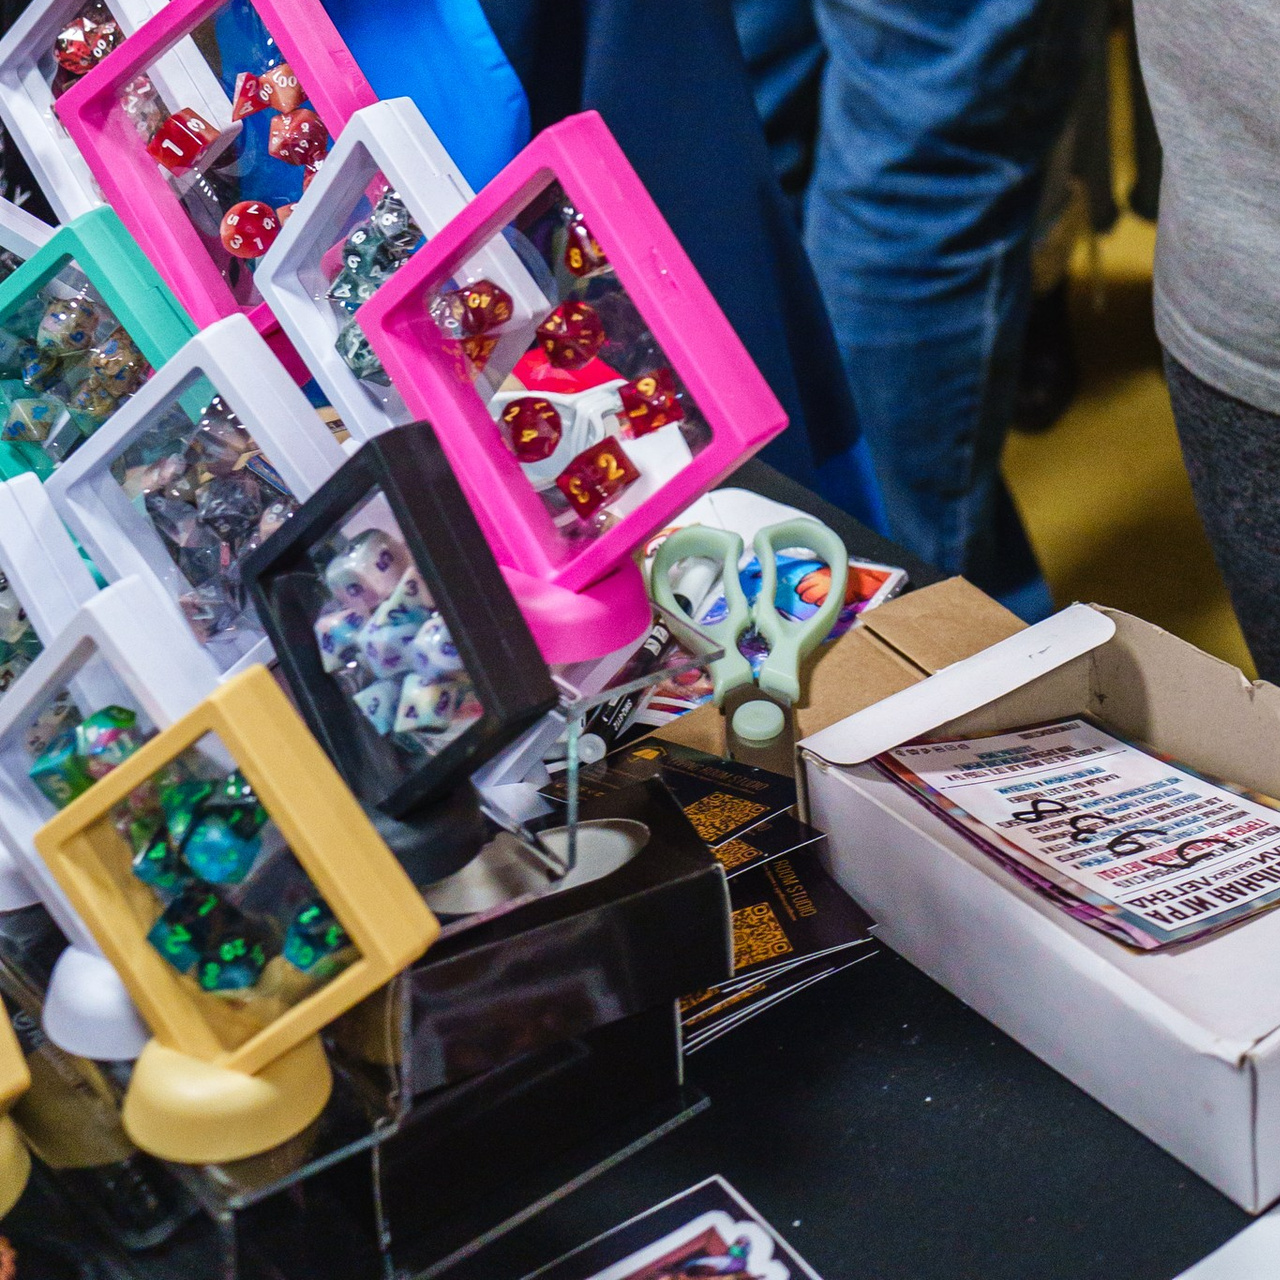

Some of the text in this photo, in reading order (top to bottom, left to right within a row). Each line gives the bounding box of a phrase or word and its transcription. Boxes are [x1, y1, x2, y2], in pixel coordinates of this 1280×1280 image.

[1221, 818, 1269, 838] ГЕРОЕМ
[1207, 859, 1256, 881] БЫЛЫХ
[773, 859, 801, 886] ROOM
[787, 884, 818, 918] STUDIO
[1121, 875, 1216, 912] ЛЕГЕНД
[1142, 894, 1216, 926] ИГРА
